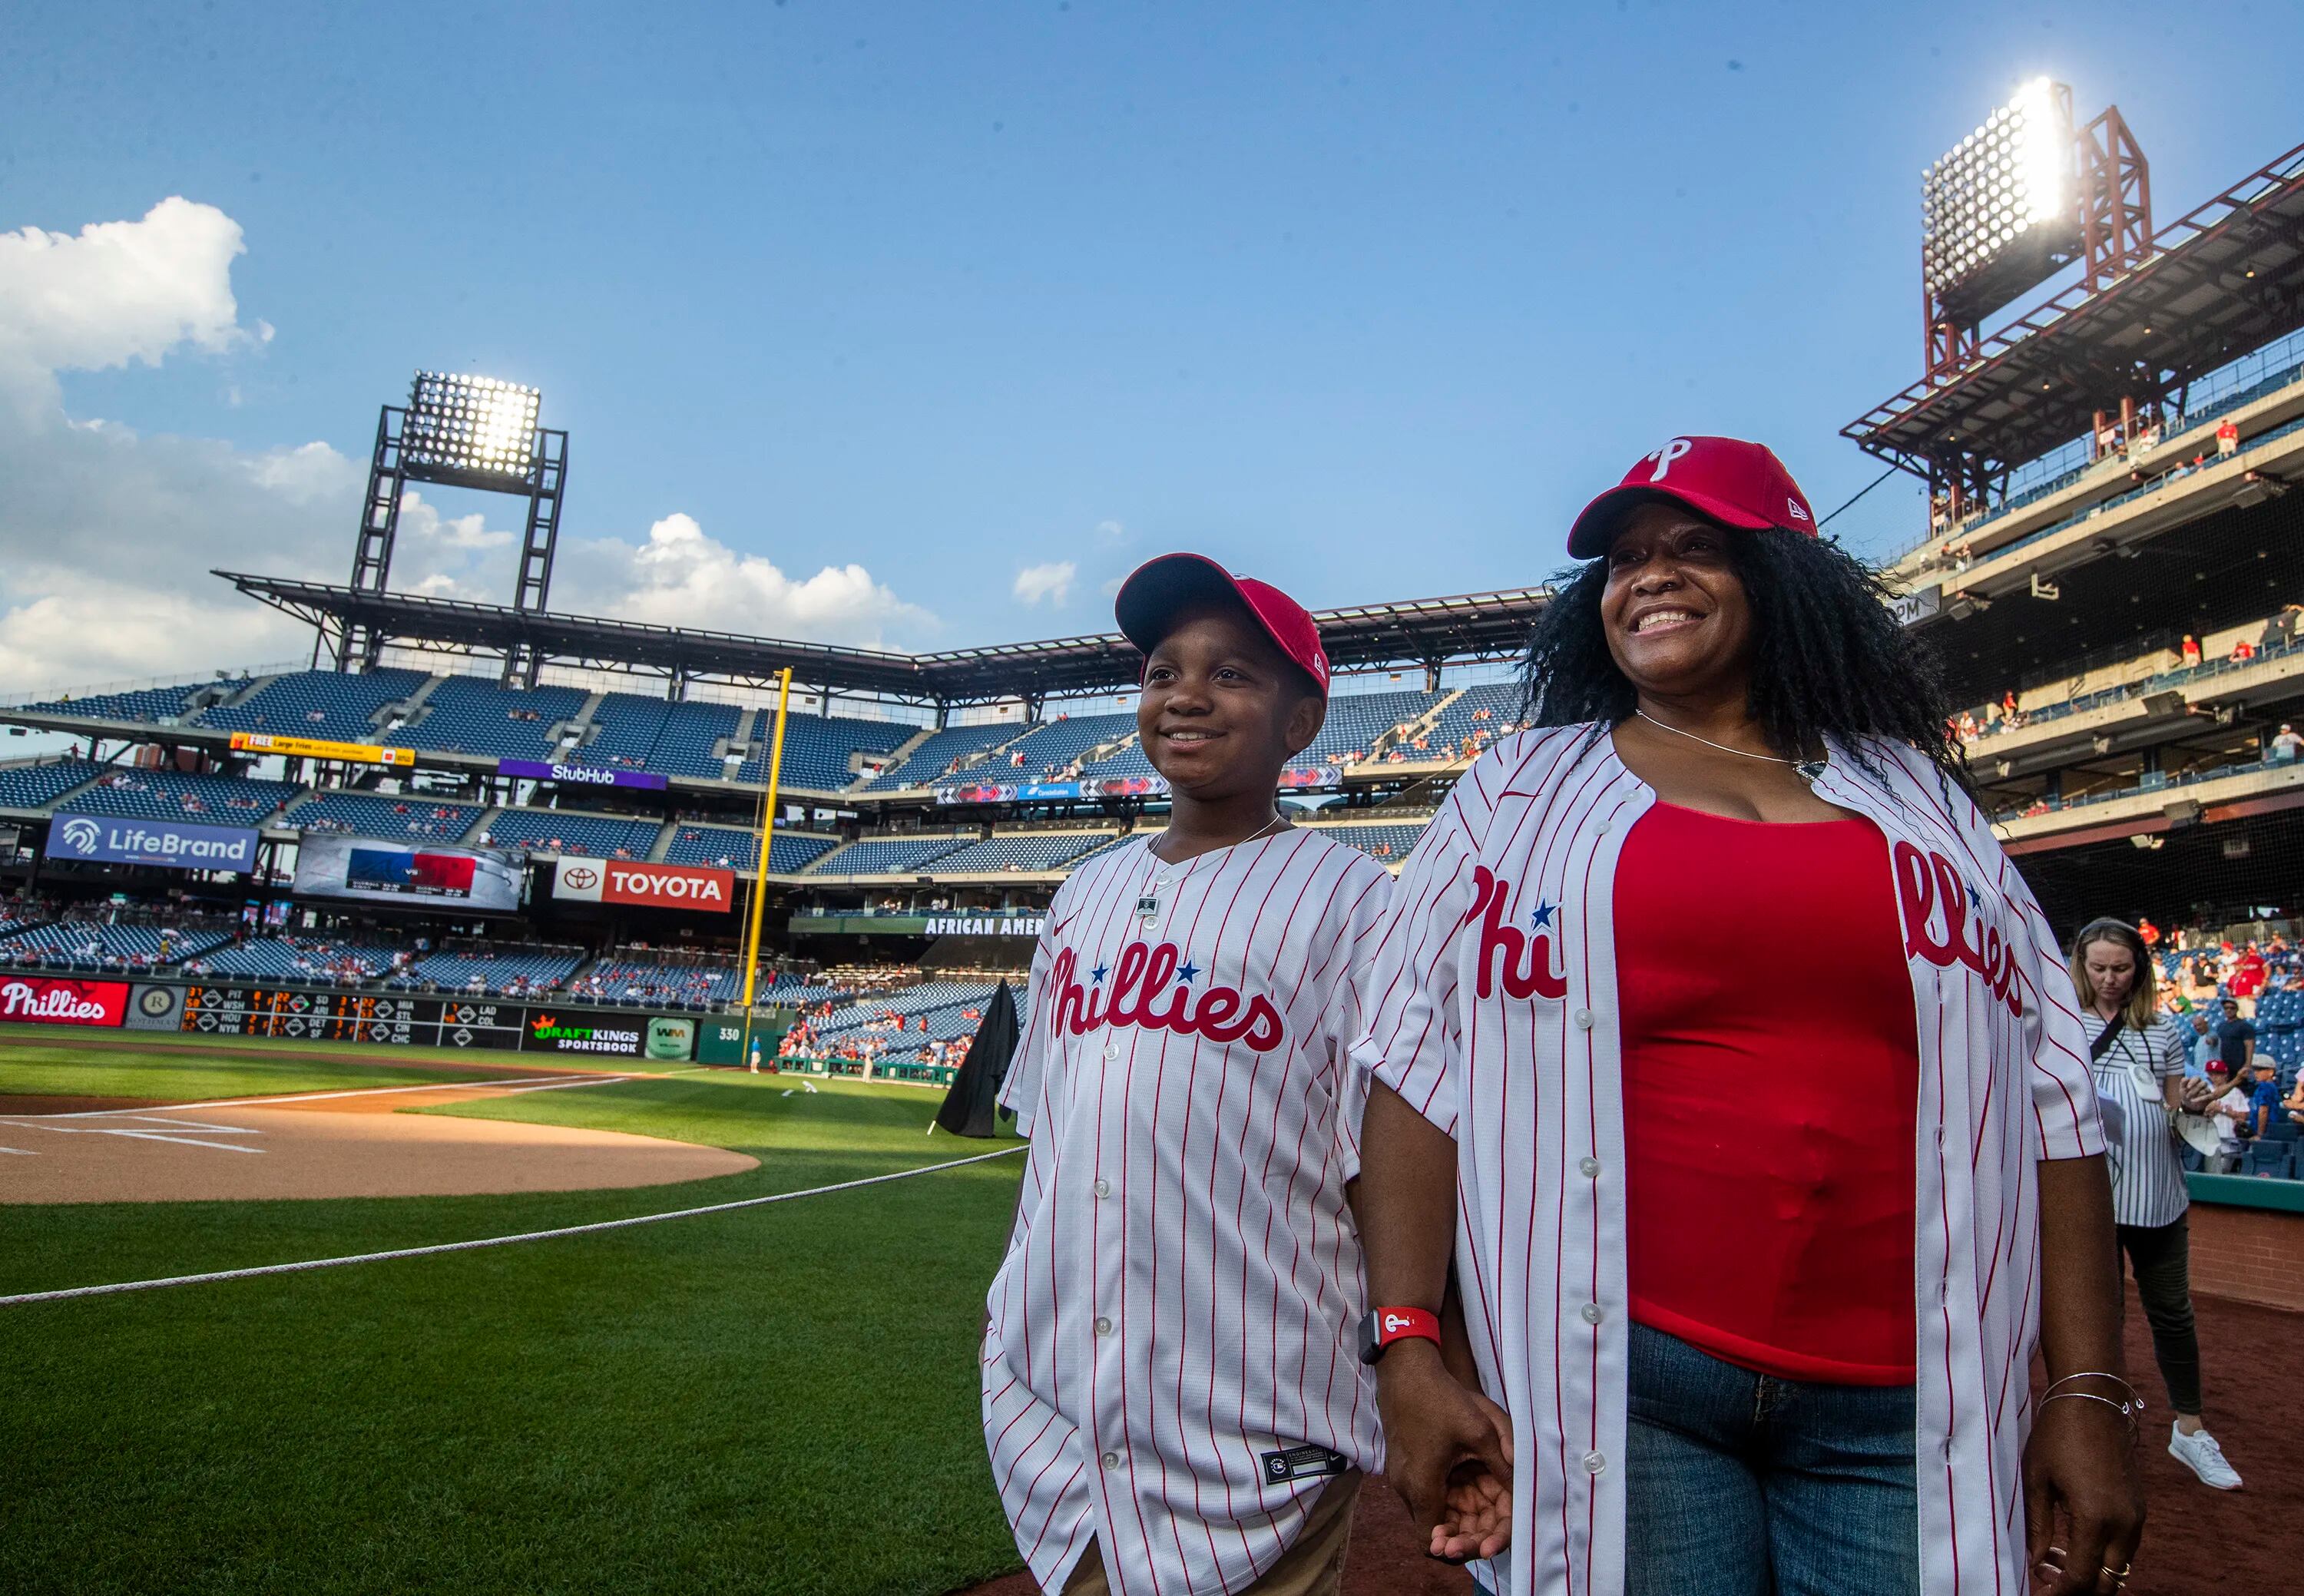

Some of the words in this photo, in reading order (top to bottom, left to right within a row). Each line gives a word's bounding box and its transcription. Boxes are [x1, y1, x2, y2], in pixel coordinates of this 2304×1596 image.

[1648, 439, 1692, 482] P
[247, 734, 273, 747] FREE
[273, 738, 293, 750] Large
[295, 741, 313, 750] Fries
[551, 764, 614, 785] StubHub
[1038, 789, 1069, 798] Constellation
[108, 829, 247, 859] LifeBrand
[611, 871, 722, 900] TOYOTA
[925, 918, 994, 935] AFRICAN
[227, 989, 243, 999] PIT
[2, 982, 105, 1019] Phillies
[151, 995, 163, 1008] R
[316, 995, 329, 1005] SD
[397, 1000, 415, 1010] MIA
[223, 1001, 245, 1010] WSH
[313, 1006, 329, 1015] ARI
[479, 1006, 497, 1015] LAD
[220, 1013, 242, 1023] HOU
[396, 1011, 412, 1021] STL
[478, 1016, 495, 1026] COL
[309, 1018, 327, 1028] DET
[218, 1024, 240, 1034] NYM
[310, 1029, 323, 1038] SF
[395, 1024, 410, 1033] CIN
[657, 1027, 685, 1038] WM
[391, 1034, 411, 1044] CHC
[534, 1027, 639, 1042] DRAFTKINGS
[719, 1028, 740, 1041] 330
[558, 1039, 637, 1053] SPORTSBOOK
